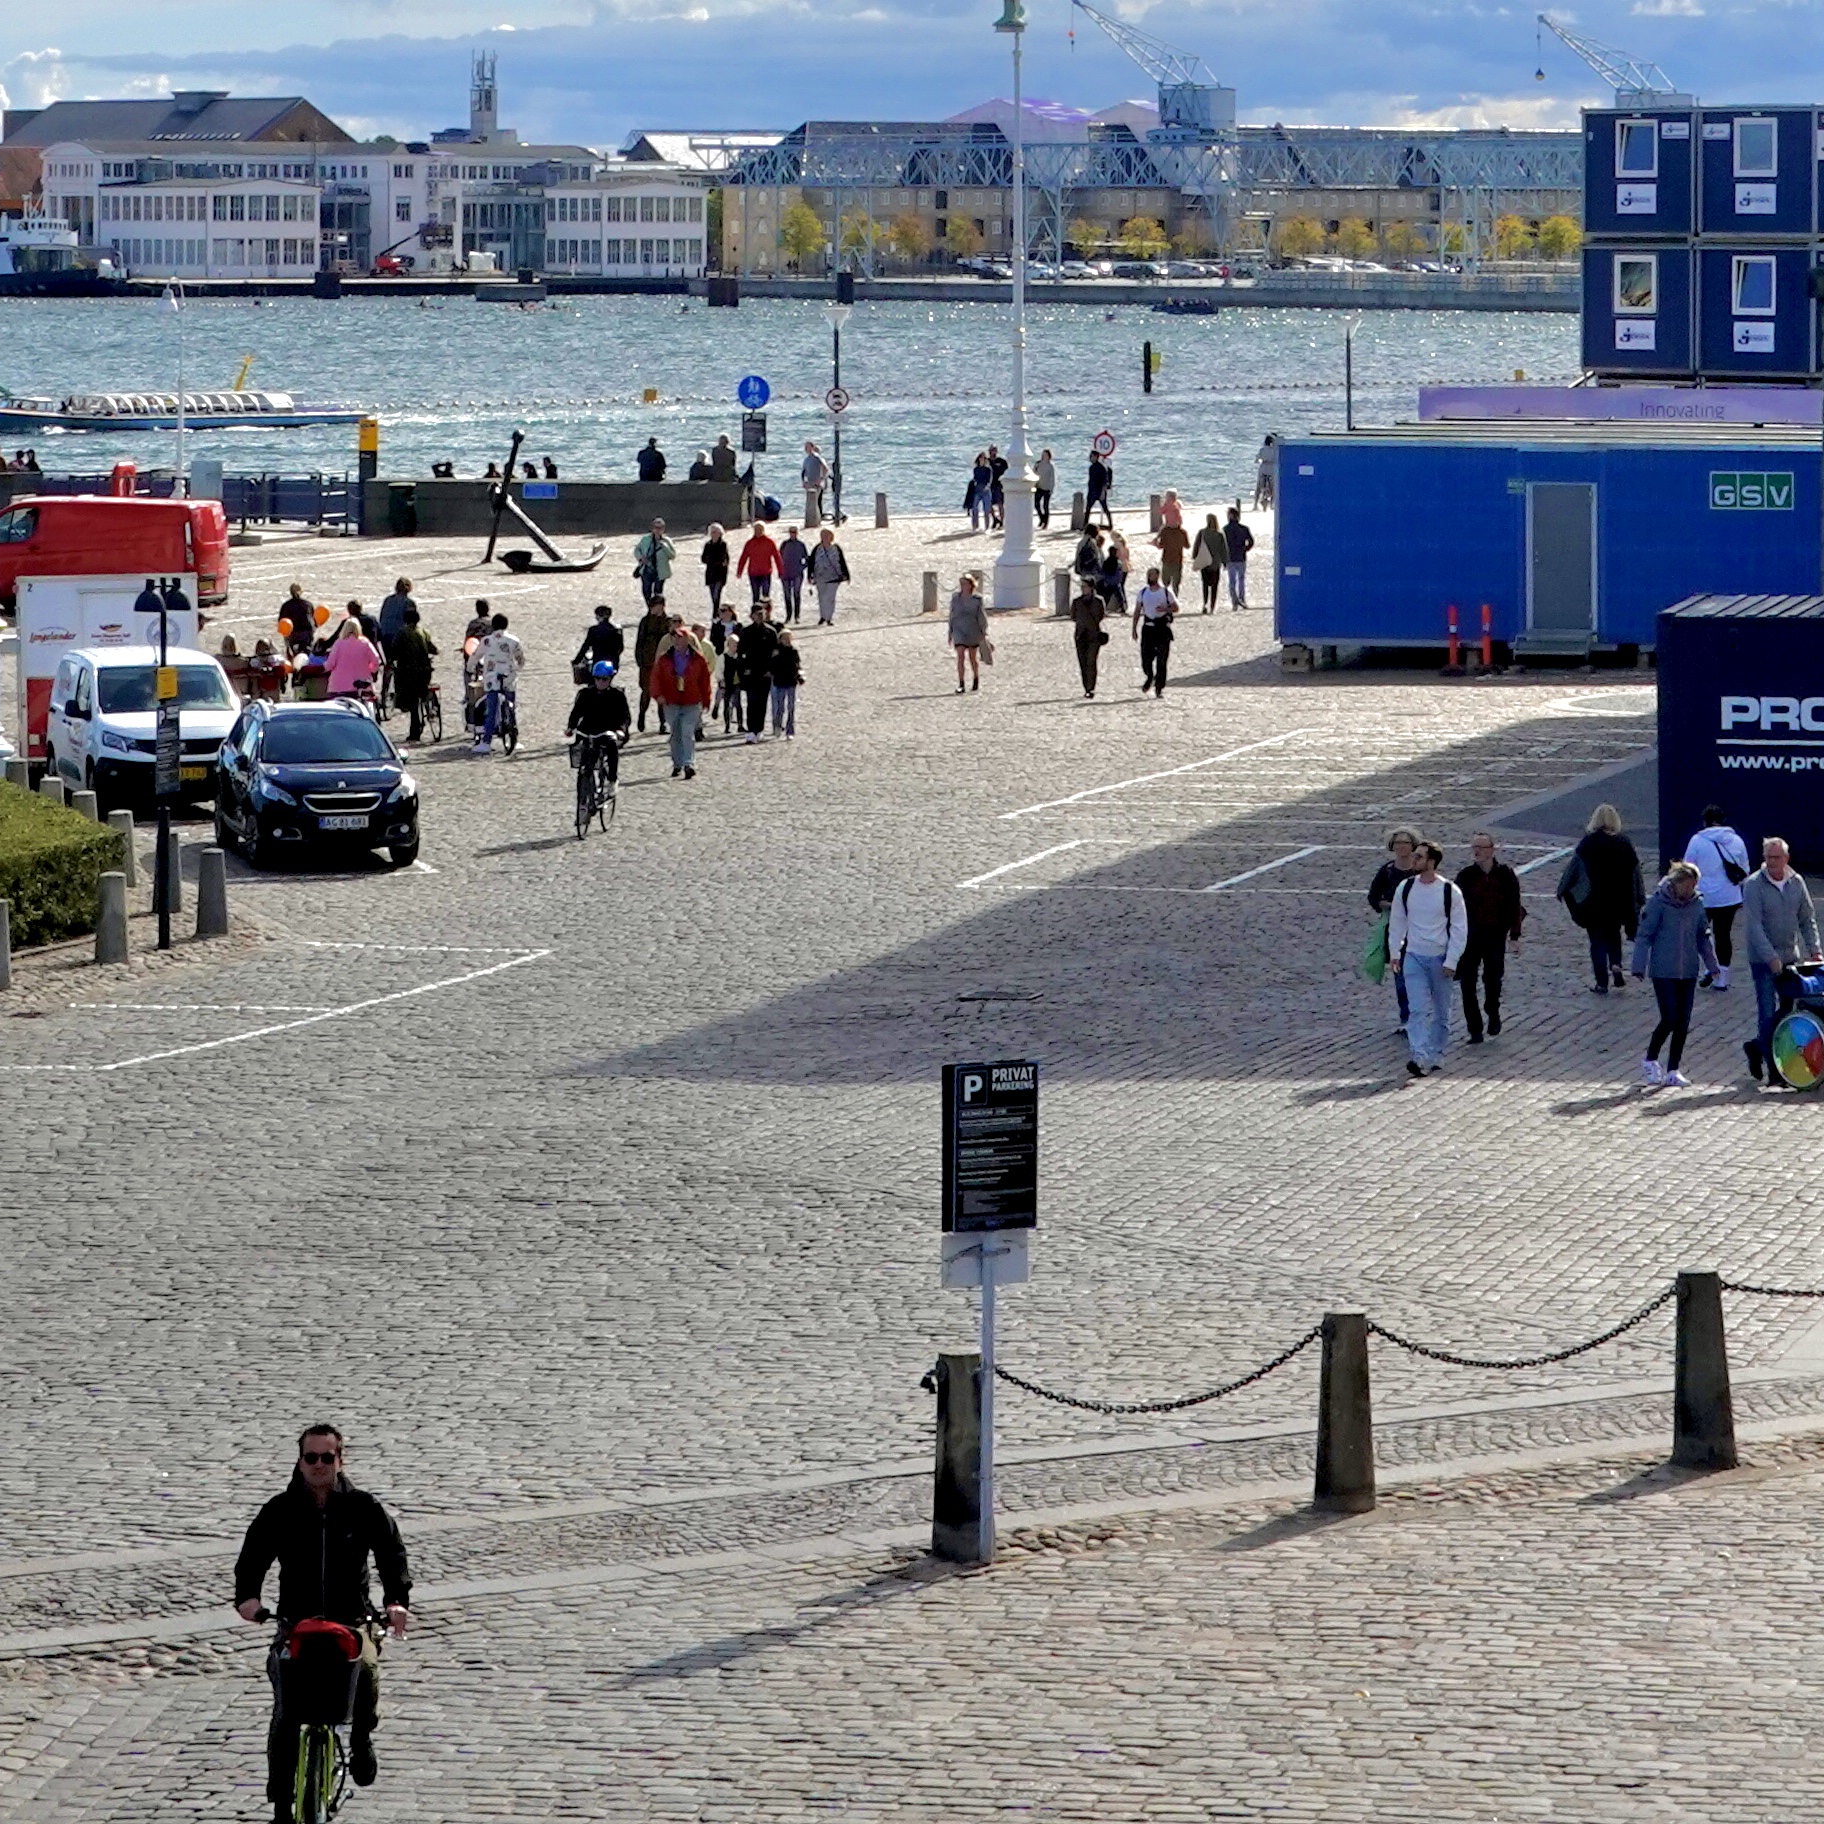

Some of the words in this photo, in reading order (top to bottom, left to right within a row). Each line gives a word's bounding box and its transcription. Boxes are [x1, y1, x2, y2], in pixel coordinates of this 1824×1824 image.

[1640, 402, 1725, 420] Innovating
[1099, 439, 1111, 451] 10
[1713, 485, 1790, 506] GSV
[27, 583, 33, 592] 2
[992, 1066, 1034, 1082] PRIVAT
[964, 1074, 983, 1103] P
